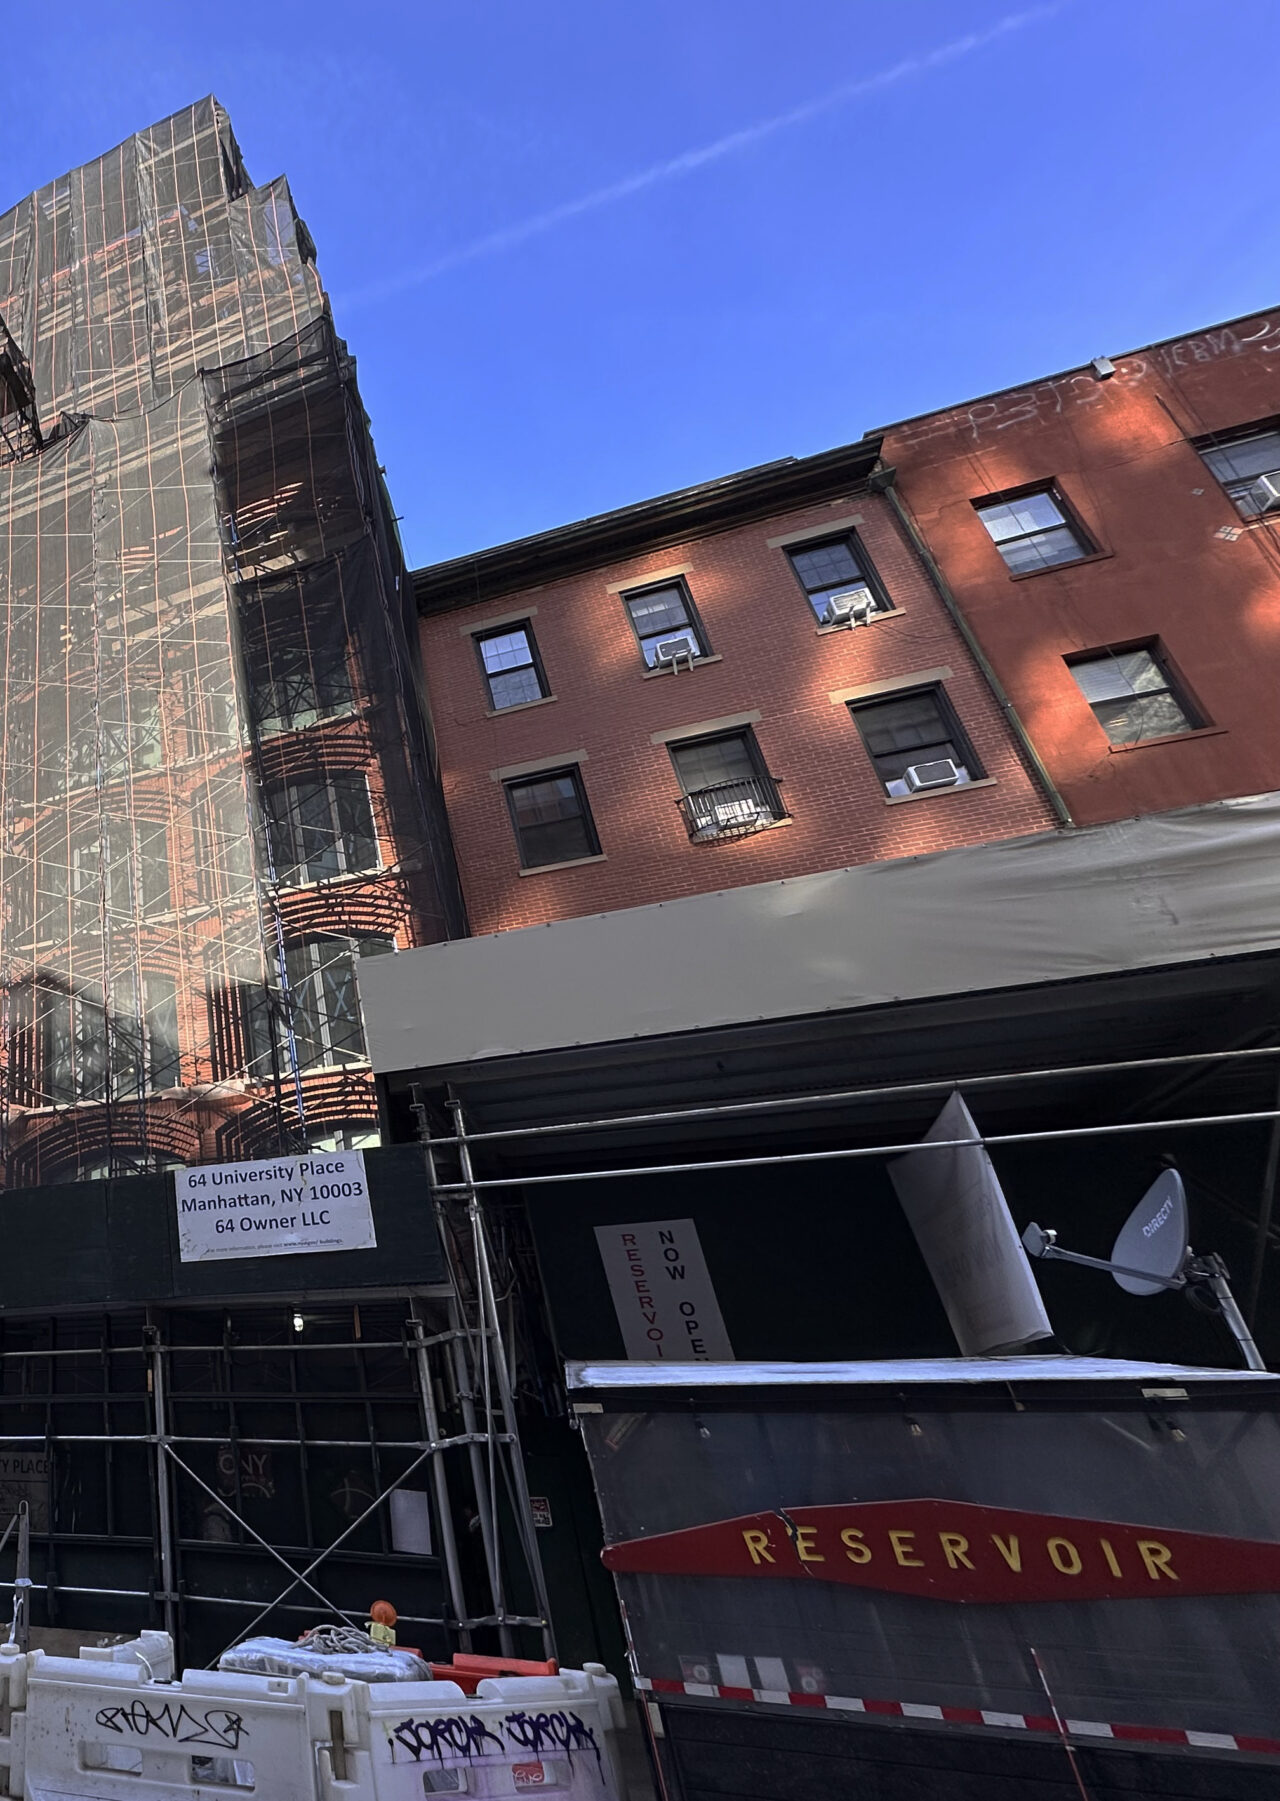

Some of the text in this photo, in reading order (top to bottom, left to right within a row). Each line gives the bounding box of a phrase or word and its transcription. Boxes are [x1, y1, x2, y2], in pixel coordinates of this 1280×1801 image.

[188, 1161, 345, 1189] 64 University Place
[181, 1181, 363, 1213] Manhattan, NY 10003
[215, 1210, 331, 1234] 64 Owner LLC
[621, 1233, 664, 1358] RESERVOI
[658, 1230, 710, 1361] NOW OPE
[12, 1458, 49, 1474] PLACE
[741, 1526, 1181, 1581] RESERVOIR
